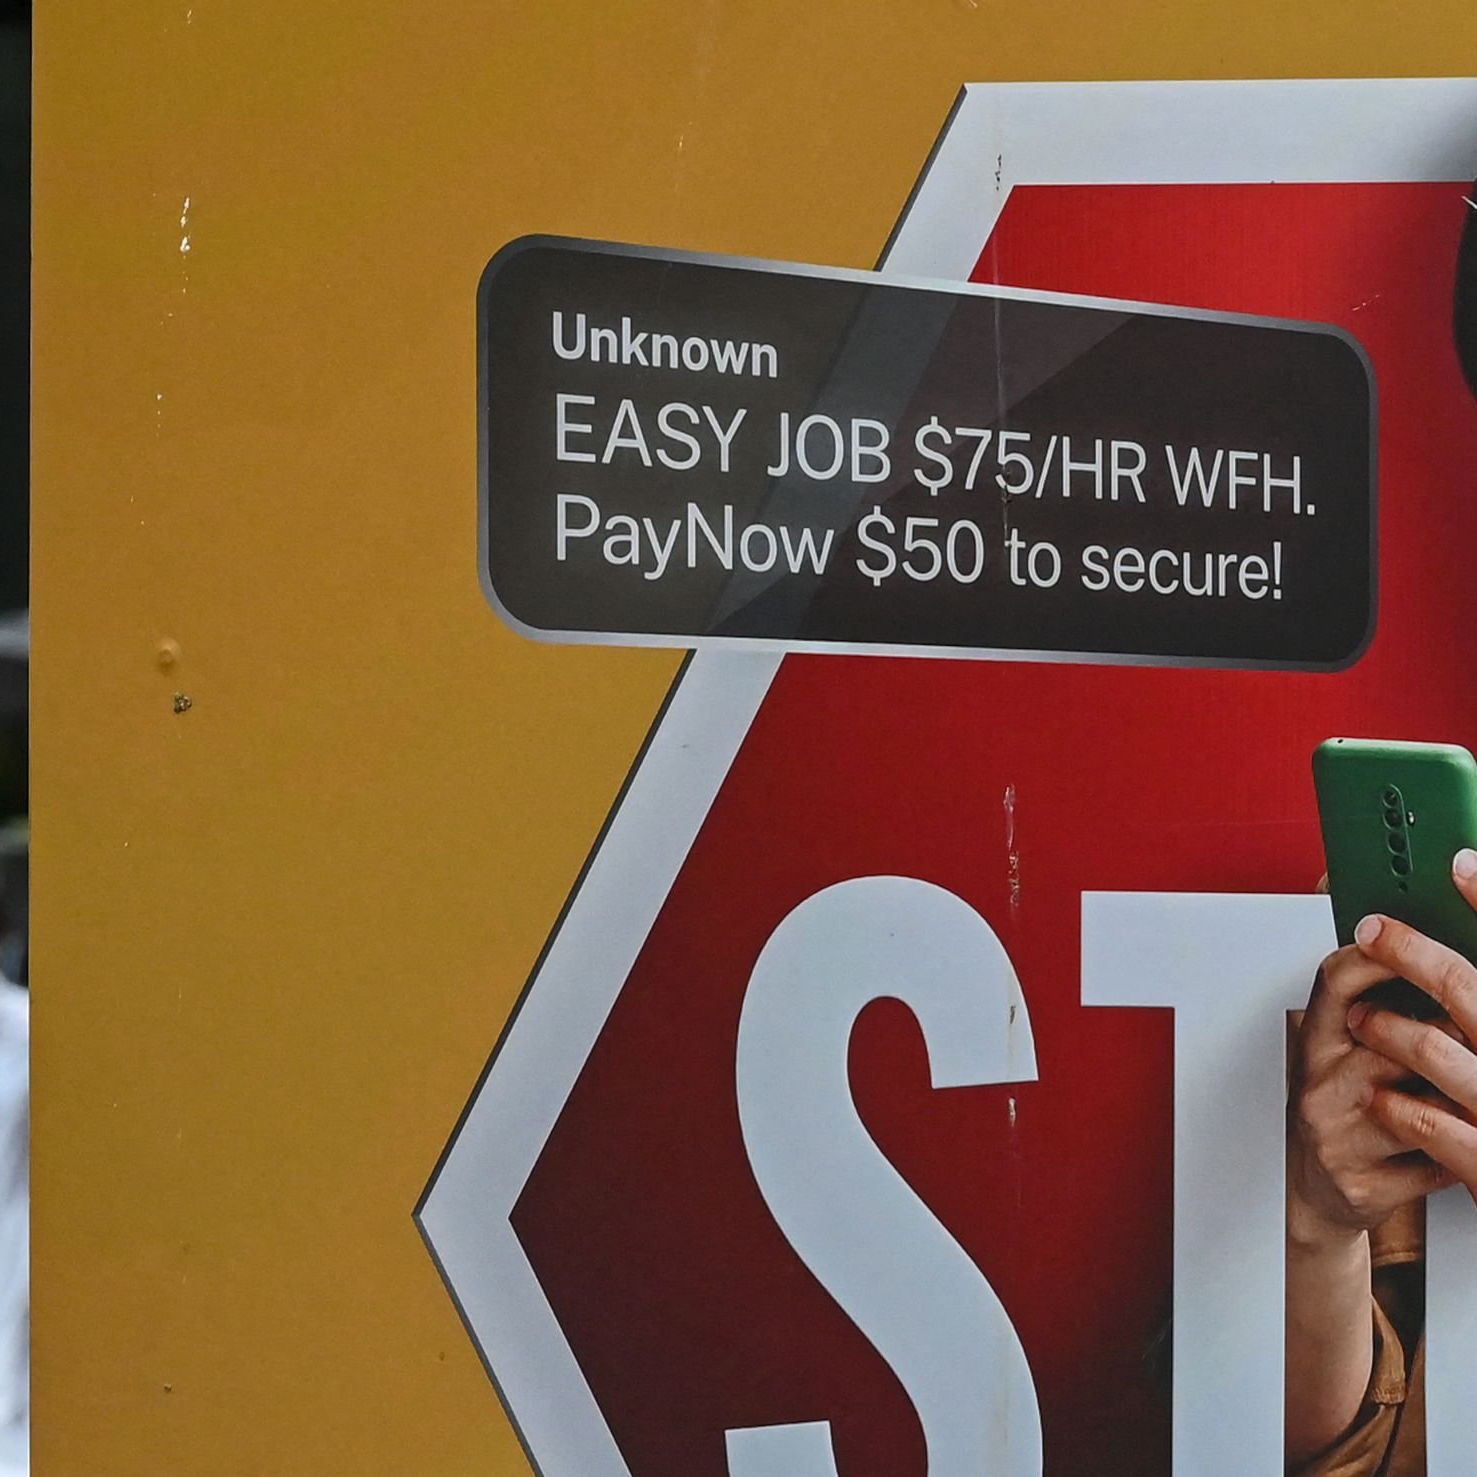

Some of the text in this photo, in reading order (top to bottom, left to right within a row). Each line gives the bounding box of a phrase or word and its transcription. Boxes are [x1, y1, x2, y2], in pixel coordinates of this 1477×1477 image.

[552, 311, 778, 379] Unknown
[555, 393, 1316, 517] EASY JOB $75/HR WFH.
[556, 494, 1283, 600] PayNow $50 to secure!
